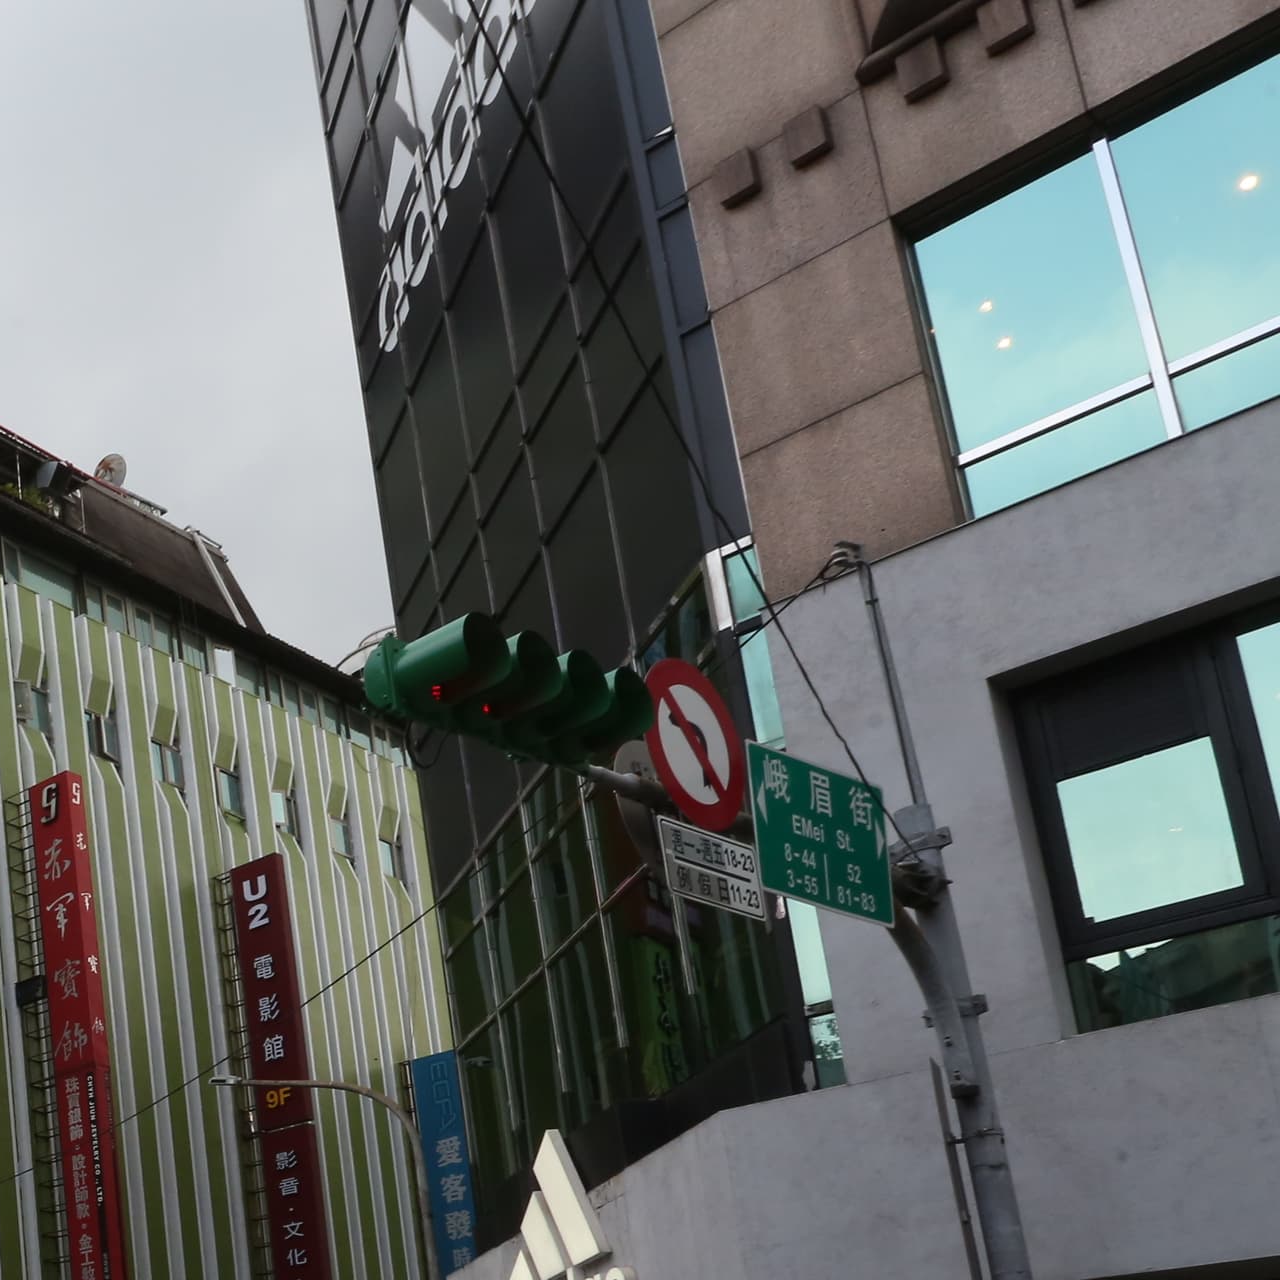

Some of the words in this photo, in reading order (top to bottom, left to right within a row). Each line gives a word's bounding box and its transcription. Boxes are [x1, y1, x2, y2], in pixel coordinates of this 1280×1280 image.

[763, 753, 873, 832] 峨眉街
[792, 814, 825, 842] EMei
[724, 847, 756, 874] 18-23
[784, 843, 817, 870] 8-44
[787, 870, 819, 896] 3-55
[847, 864, 862, 885] 52
[242, 874, 269, 930] U2
[730, 883, 760, 909] 11-23
[253, 954, 285, 1062] 電影館
[266, 1087, 292, 1110] 9F
